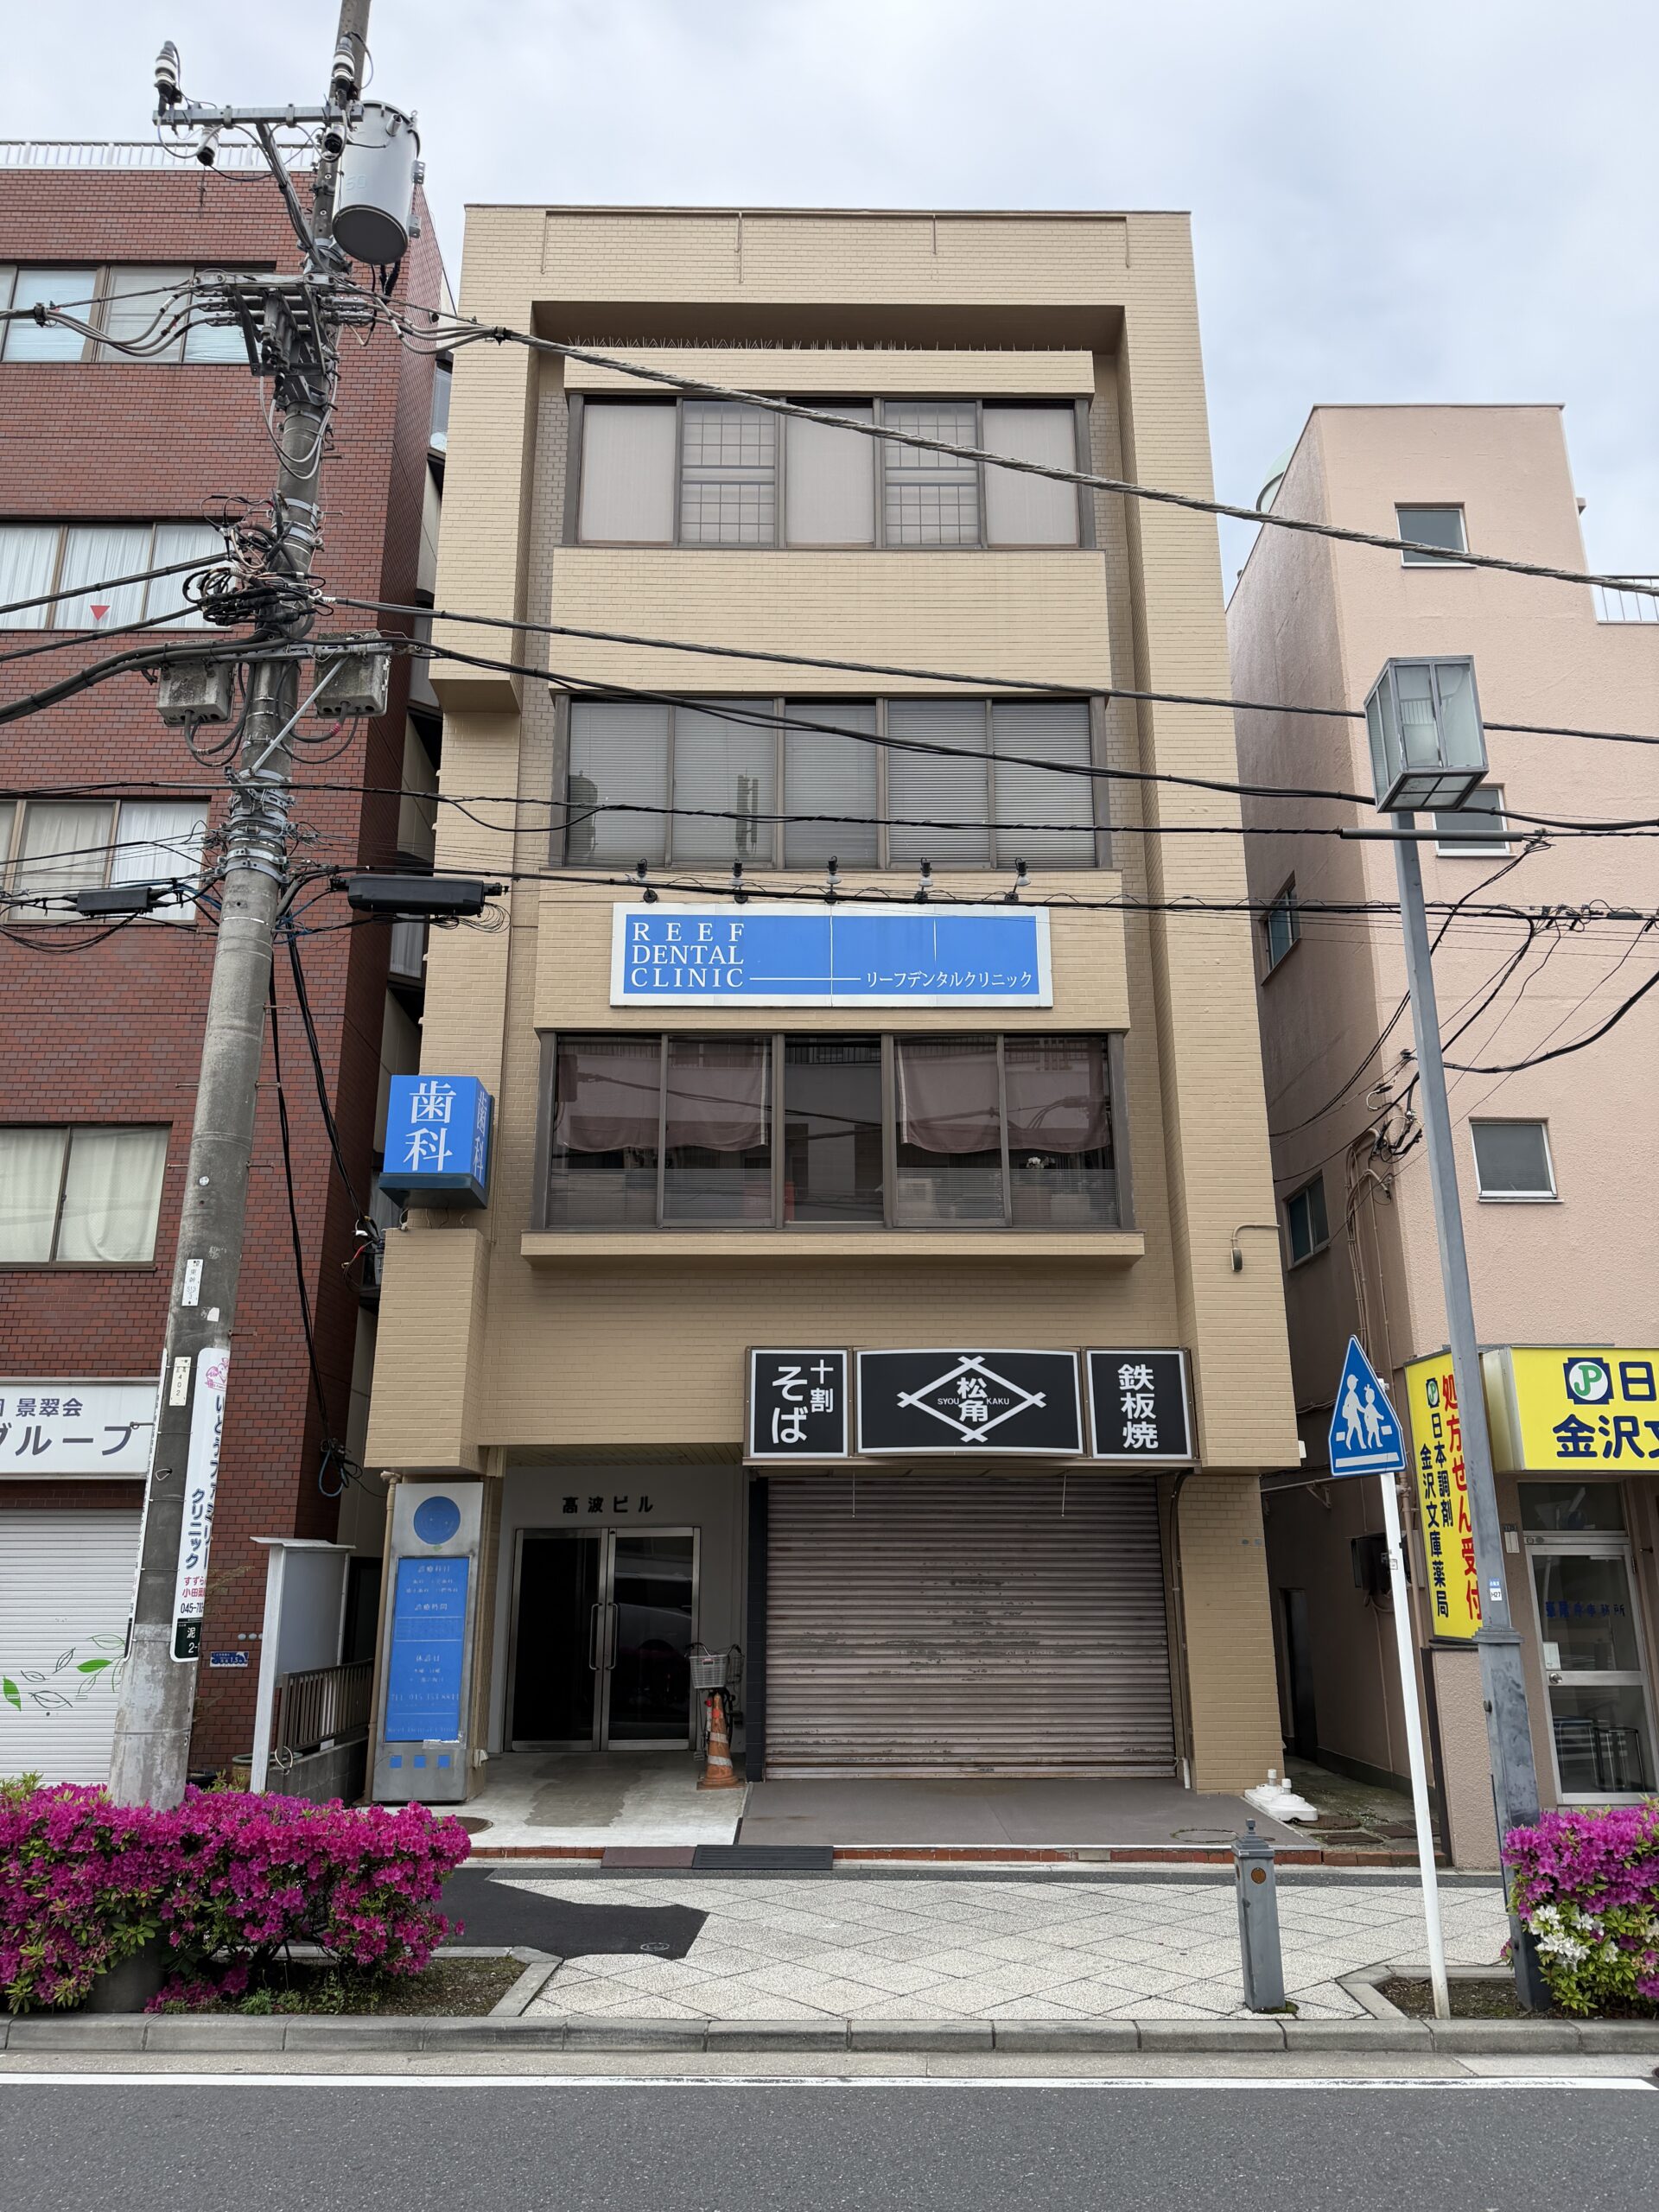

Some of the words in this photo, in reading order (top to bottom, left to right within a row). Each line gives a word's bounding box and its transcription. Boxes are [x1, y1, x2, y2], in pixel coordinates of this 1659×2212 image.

[632, 922, 745, 942] REEF
[632, 944, 744, 965] DENTAL
[631, 968, 743, 988] CLINIC
[867, 970, 1032, 988] リーフデンタルクリニック
[403, 1080, 457, 1172] 歯科
[16, 1397, 84, 1417] 景翠会
[772, 1366, 809, 1444] そば
[810, 1359, 834, 1413] 十割
[957, 1377, 988, 1422] 松角
[1117, 1364, 1159, 1449] 鉄板焼
[1431, 1413, 1454, 1528] 日本調剤
[185, 1489, 206, 1570] クリニック
[1420, 1443, 1449, 1618] 金沢文庫薬局
